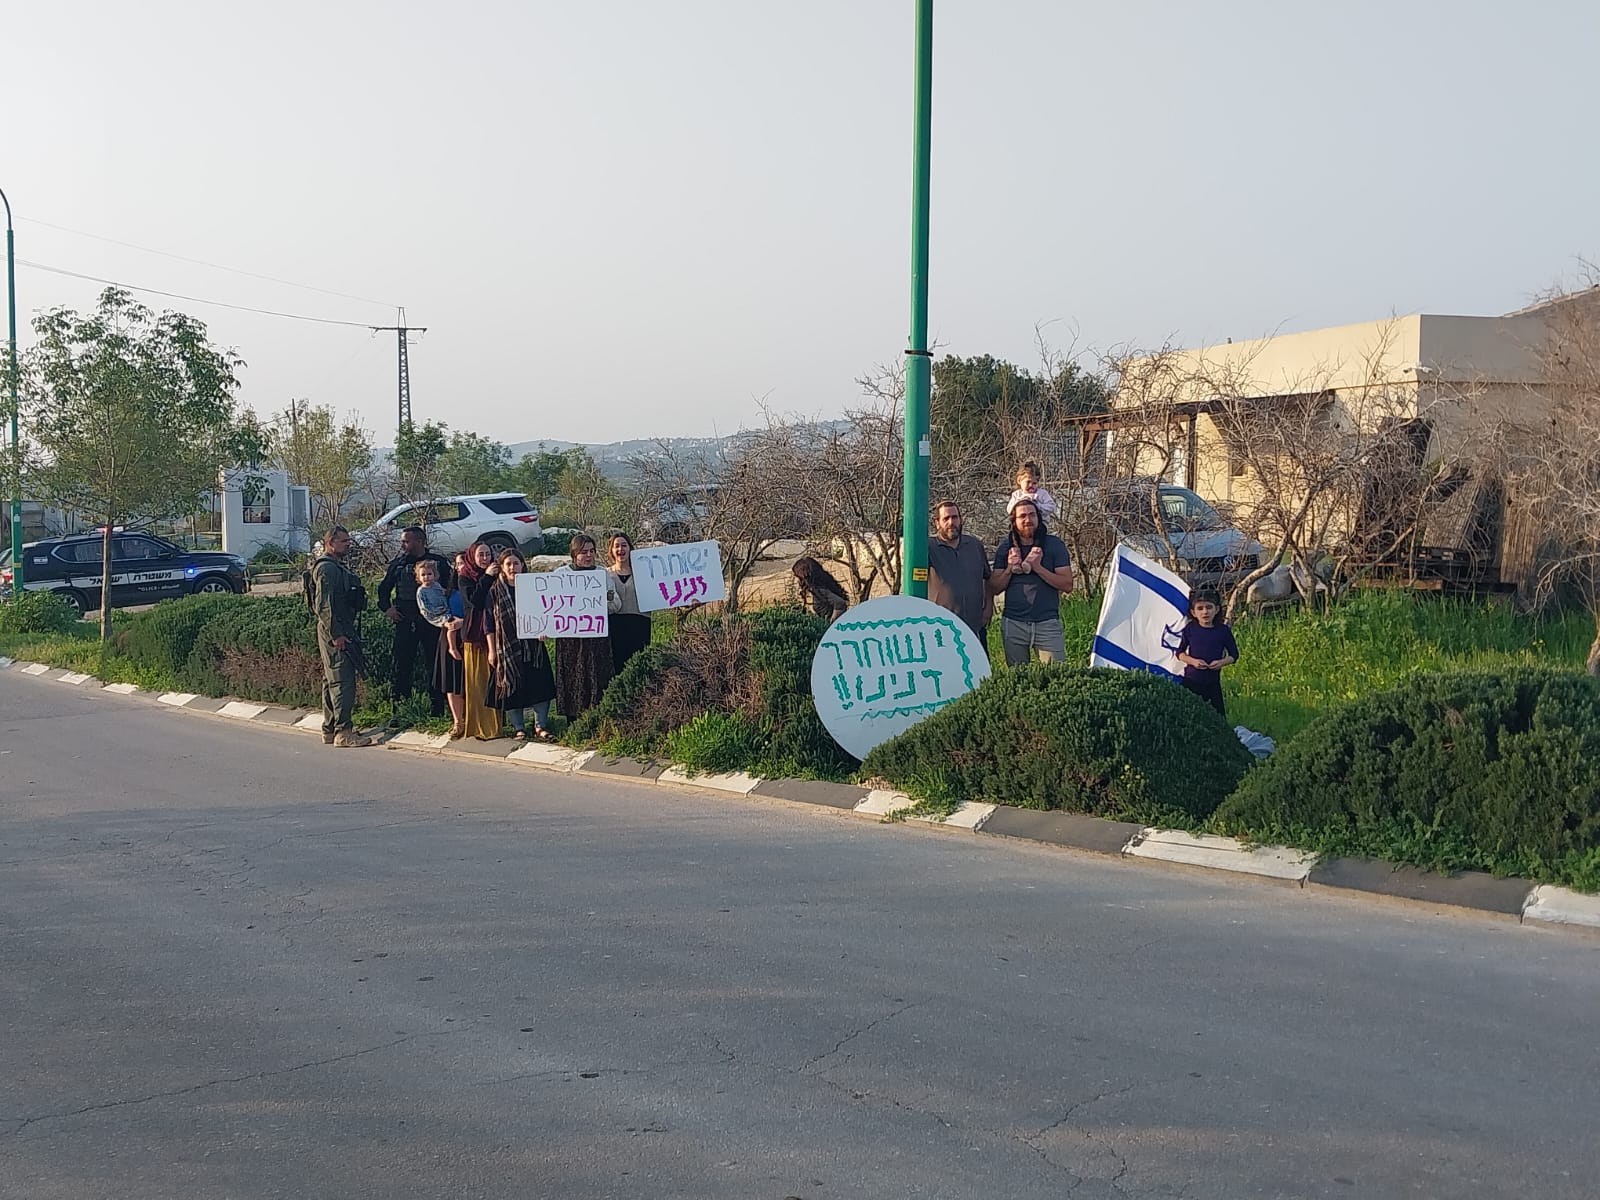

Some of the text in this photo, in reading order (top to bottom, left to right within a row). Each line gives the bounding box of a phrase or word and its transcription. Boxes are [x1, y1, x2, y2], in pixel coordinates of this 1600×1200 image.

[89, 571, 172, 585] משטרת ישאל
[535, 574, 602, 591] מחזירים
[578, 595, 602, 611] את
[554, 615, 604, 634] הביתה
[821, 628, 942, 670] ישוחרר
